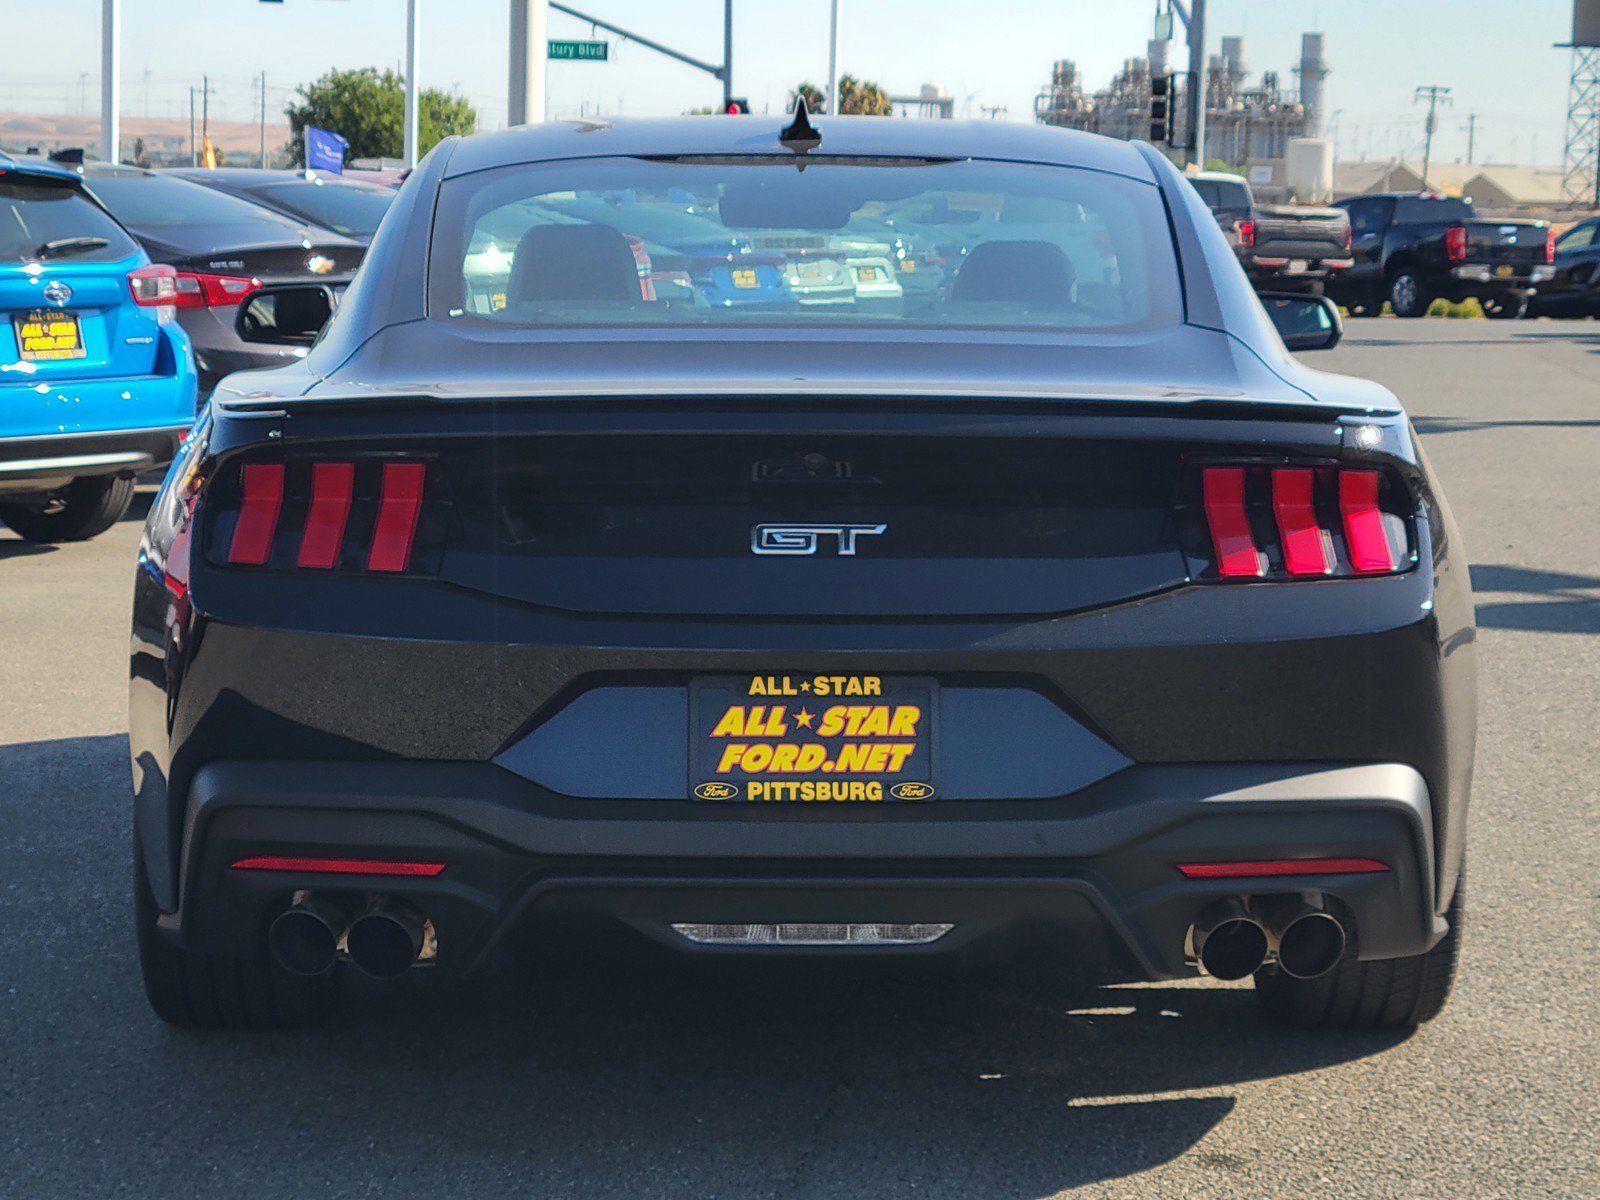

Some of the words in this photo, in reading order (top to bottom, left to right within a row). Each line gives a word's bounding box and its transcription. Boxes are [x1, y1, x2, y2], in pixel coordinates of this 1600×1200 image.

[579, 43, 604, 56] Blvd
[751, 523, 887, 555] GT
[748, 676, 798, 696] ALL
[813, 676, 881, 696] STAR
[709, 705, 789, 737] ALL
[815, 705, 921, 737] STAR
[715, 743, 916, 773] FORD.NET
[703, 785, 729, 797] Ford
[747, 781, 883, 801] PITTSBURG
[899, 785, 925, 797] Ford
